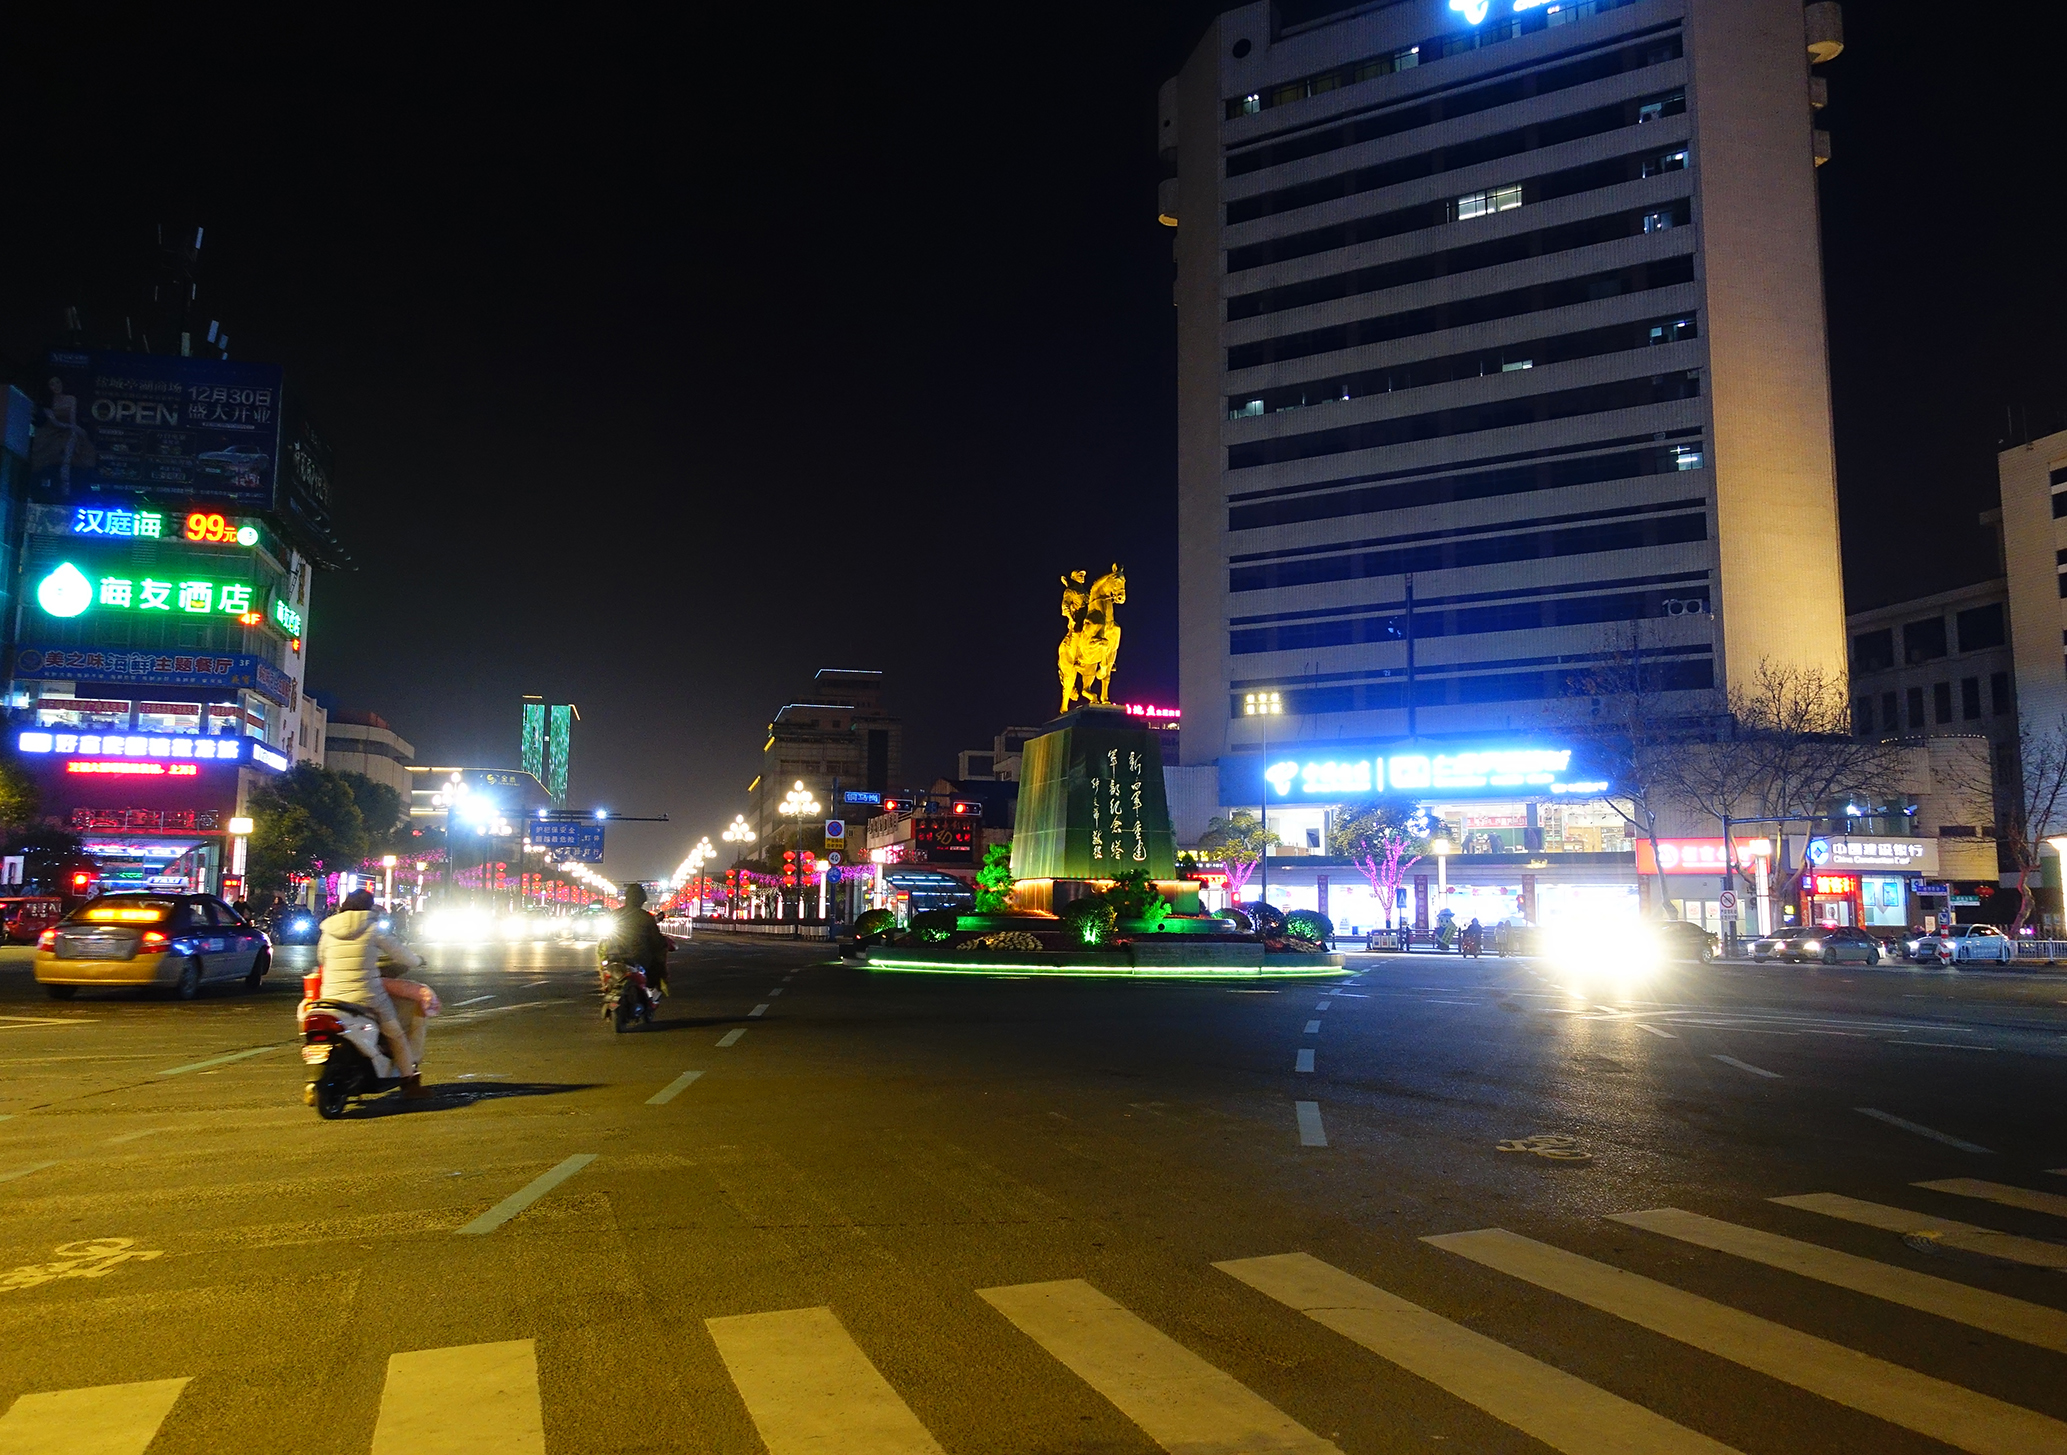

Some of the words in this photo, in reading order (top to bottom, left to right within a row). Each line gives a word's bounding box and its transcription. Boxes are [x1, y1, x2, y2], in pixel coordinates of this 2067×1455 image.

[188, 385, 272, 406] 12月30日
[91, 398, 179, 427] OPEN
[74, 508, 163, 539] 汉庭海
[186, 512, 237, 543] 99元
[99, 576, 253, 615] 海友酒店
[239, 613, 262, 626] 4F
[44, 650, 234, 675] 美之味海鲜主题餐厅
[239, 659, 250, 667] 3F
[830, 854, 839, 862] 40
[1832, 842, 1924, 858] 中国建设银行
[153, 877, 183, 885] TAXI
